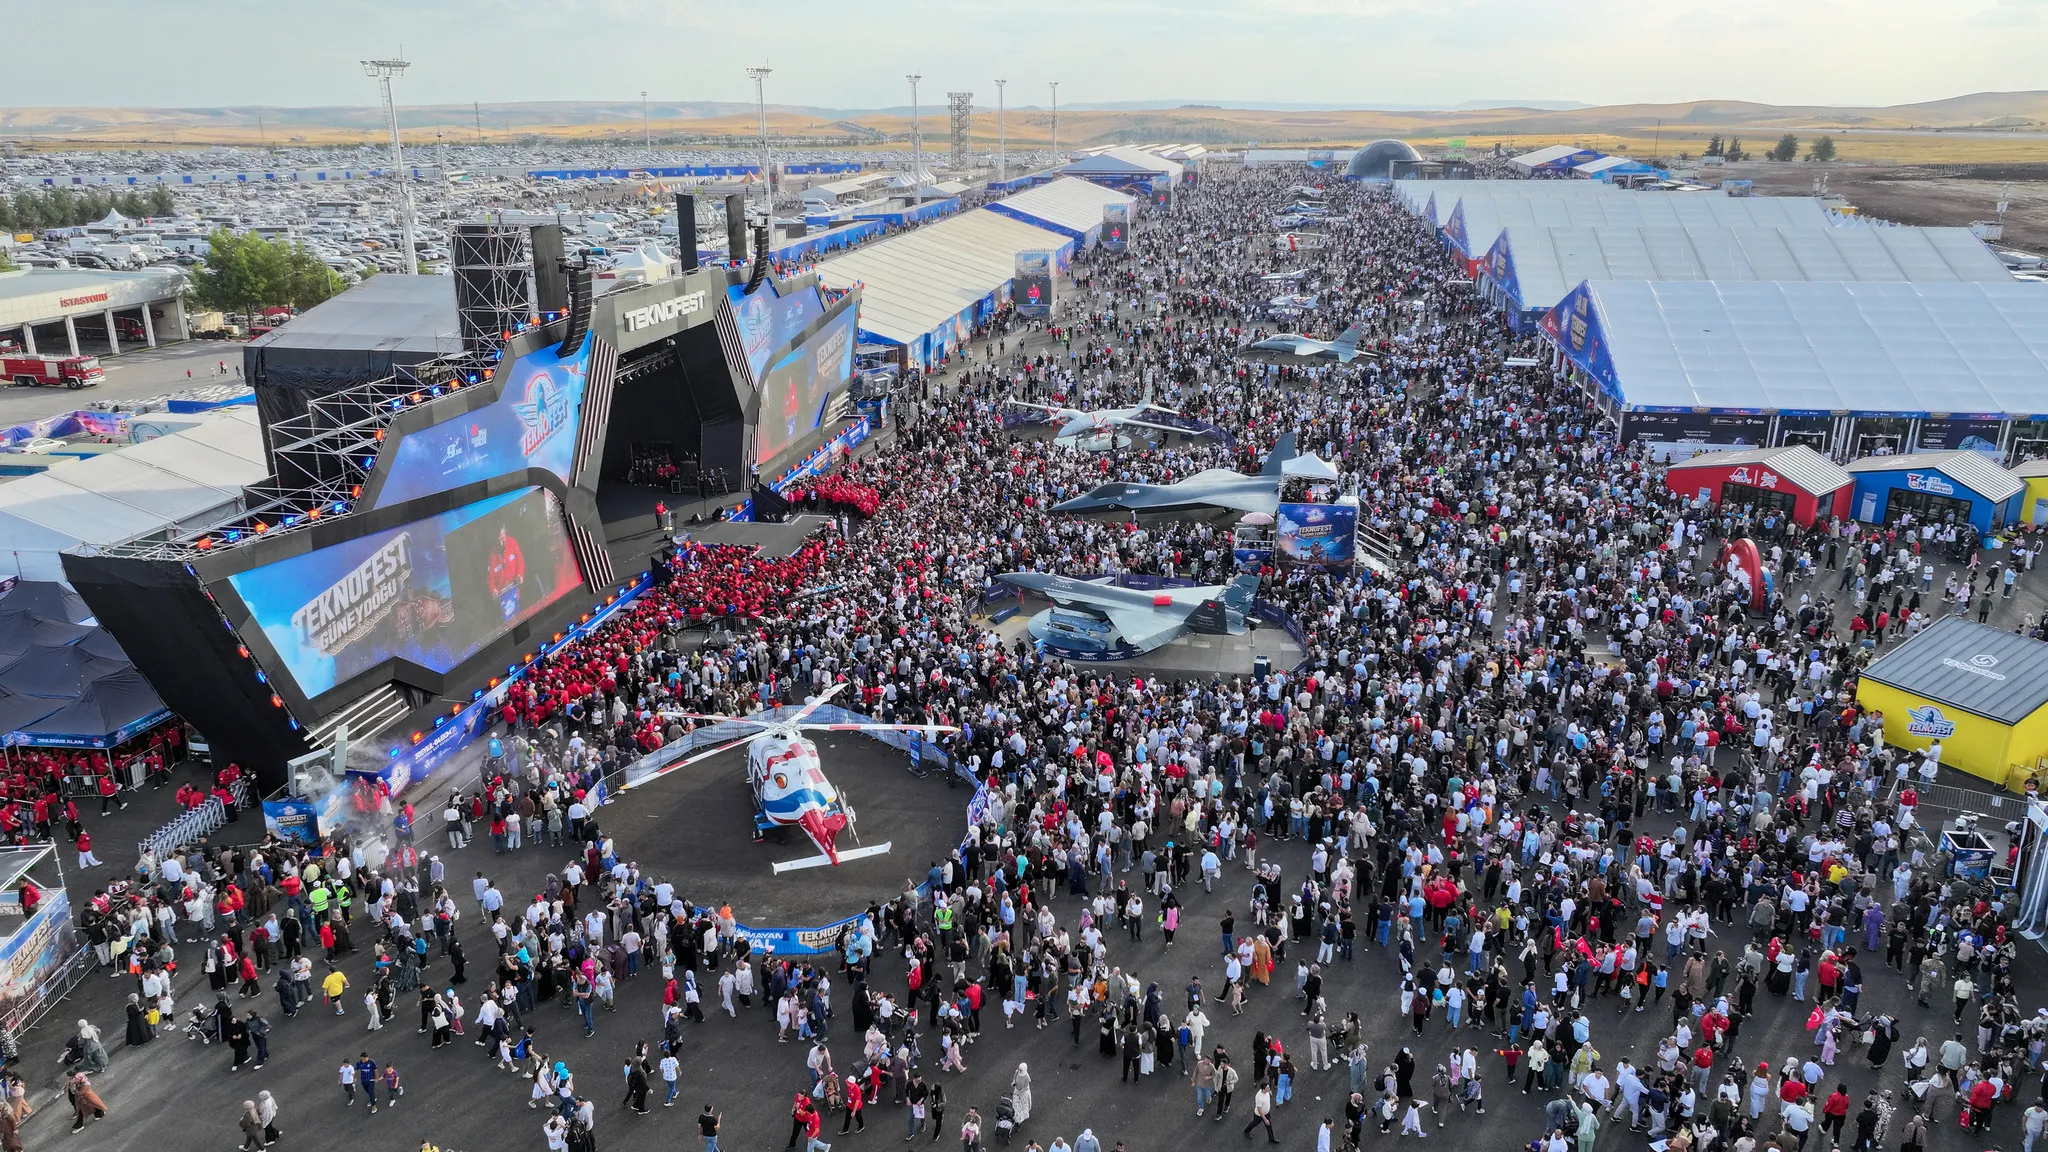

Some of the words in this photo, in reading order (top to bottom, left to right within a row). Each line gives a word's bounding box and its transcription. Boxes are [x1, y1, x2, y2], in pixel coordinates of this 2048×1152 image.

[624, 290, 706, 332] TEKNOFEST
[1299, 525, 1333, 534] TEKNOFEST
[292, 531, 410, 645] TEKNOFEST
[319, 577, 398, 651] GÜNEYDOĞU
[1908, 723, 1954, 737] TEKNOFEST
[11, 913, 51, 974] TEKNOFEST
[797, 918, 858, 941] TEKNOFST
